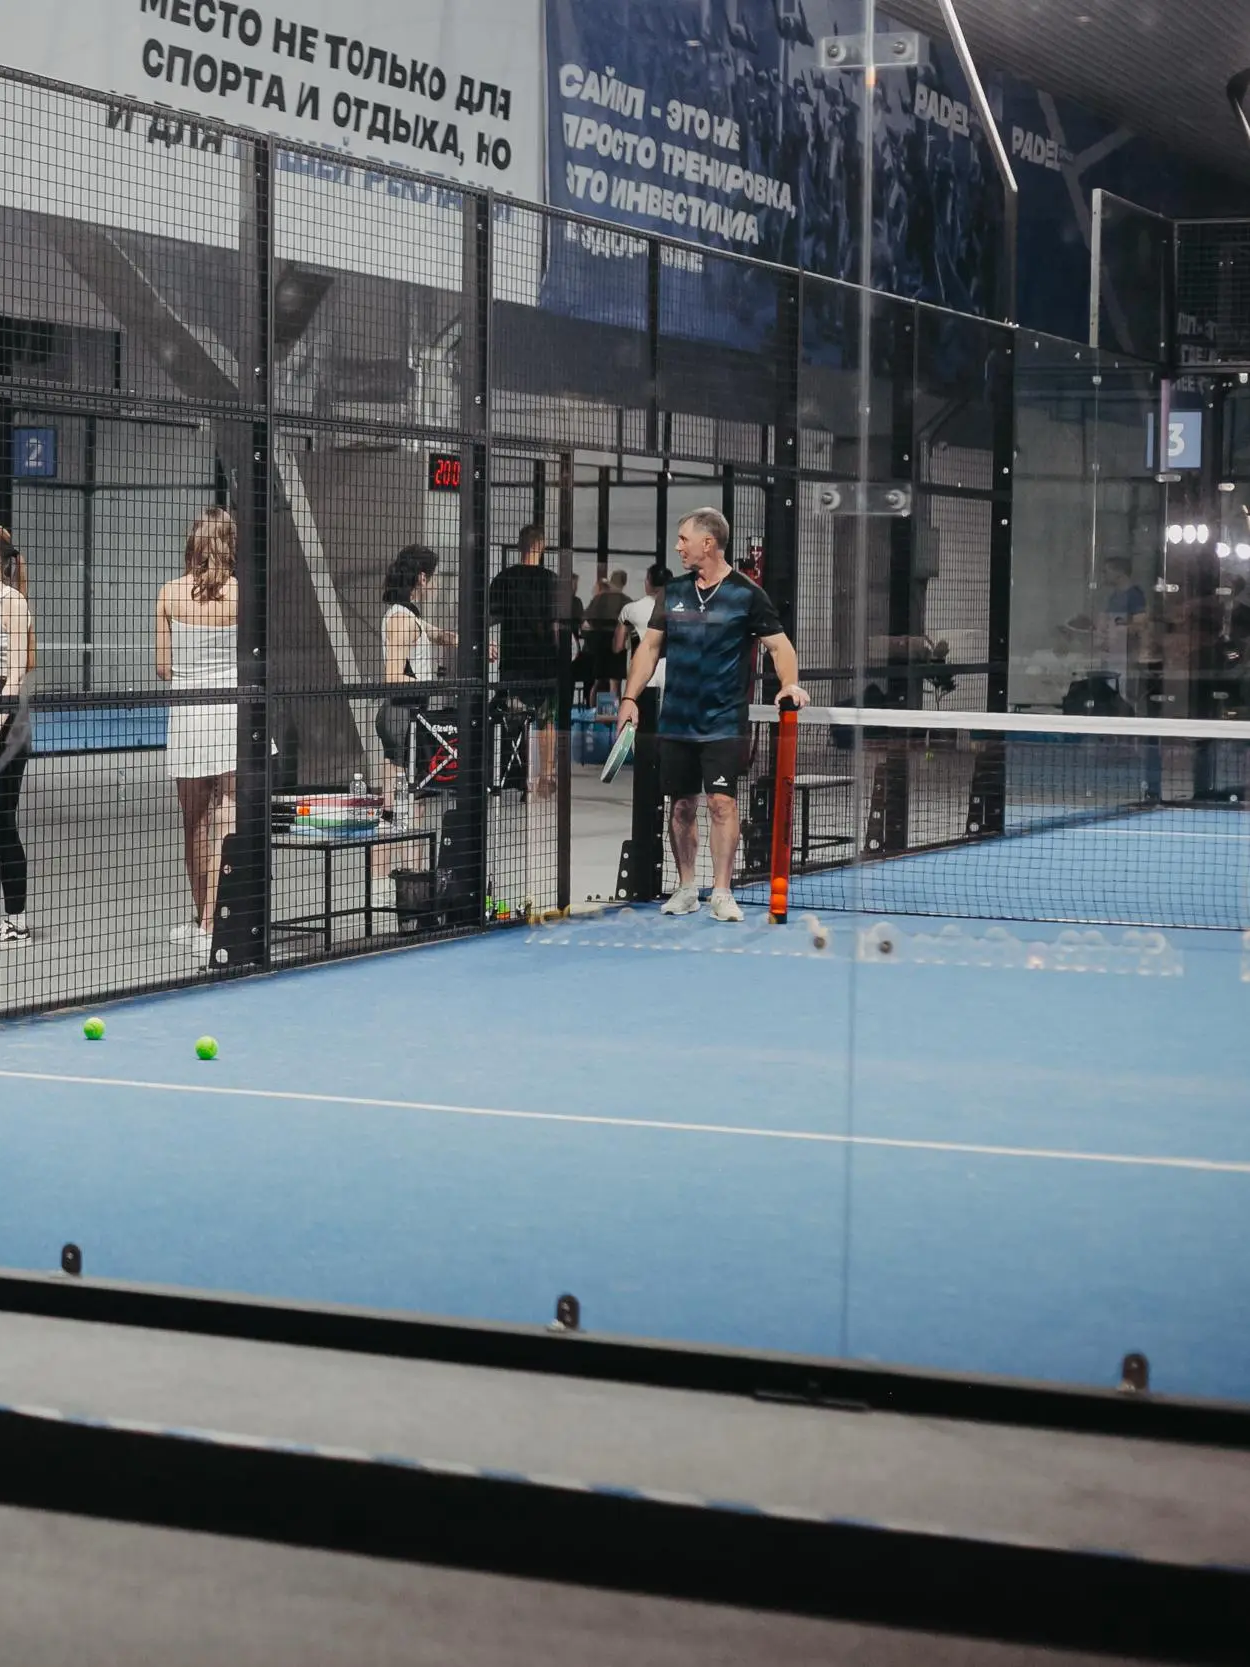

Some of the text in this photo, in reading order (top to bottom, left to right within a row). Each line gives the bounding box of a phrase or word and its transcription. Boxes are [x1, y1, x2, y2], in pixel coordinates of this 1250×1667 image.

[272, 17, 319, 63] НЕ
[325, 33, 446, 101] ТОЛЬКО
[143, 38, 286, 112] СПОРТА
[296, 82, 319, 120] И
[333, 91, 464, 166] ОТДЫХА,
[477, 131, 512, 171] НО
[666, 99, 710, 140] ЭТО
[713, 115, 740, 151] НЕ
[914, 83, 969, 137] PADEL
[562, 112, 796, 219] ПРОСТО ТРЕНИРОВКА,
[1012, 125, 1061, 171] PADEL
[566, 160, 608, 204] ЭТО
[611, 175, 759, 245] ИНВЕСТИЦИЯ
[25, 438, 43, 468] 2
[1168, 423, 1185, 457] 3
